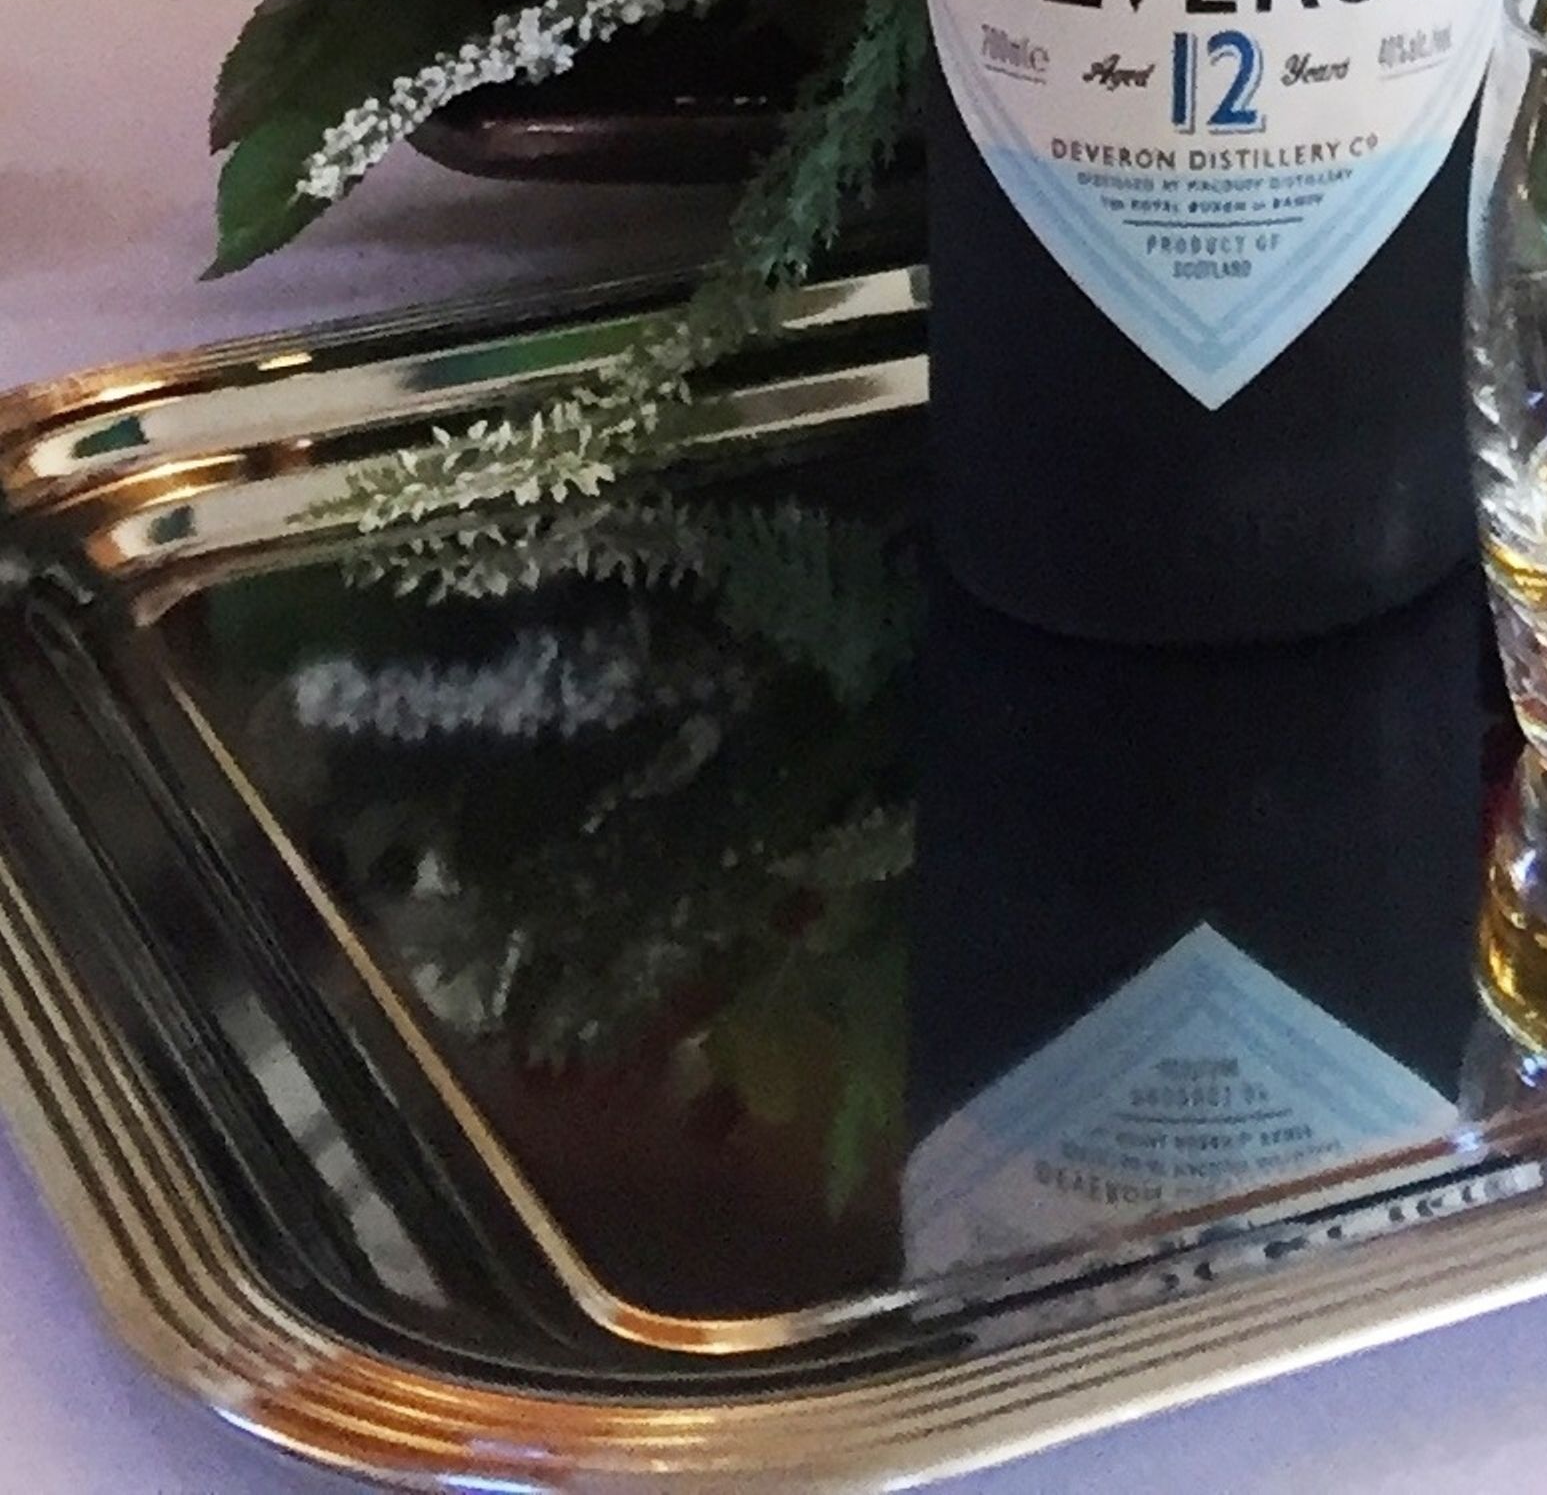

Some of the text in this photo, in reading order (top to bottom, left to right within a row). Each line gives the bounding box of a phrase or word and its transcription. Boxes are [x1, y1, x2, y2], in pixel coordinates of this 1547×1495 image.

[1082, 29, 1351, 135] Aged 12 Years
[1051, 137, 1176, 171] DEVERON
[1189, 142, 1340, 171] DISTILLERY
[1146, 234, 1245, 256] PRODUCT
